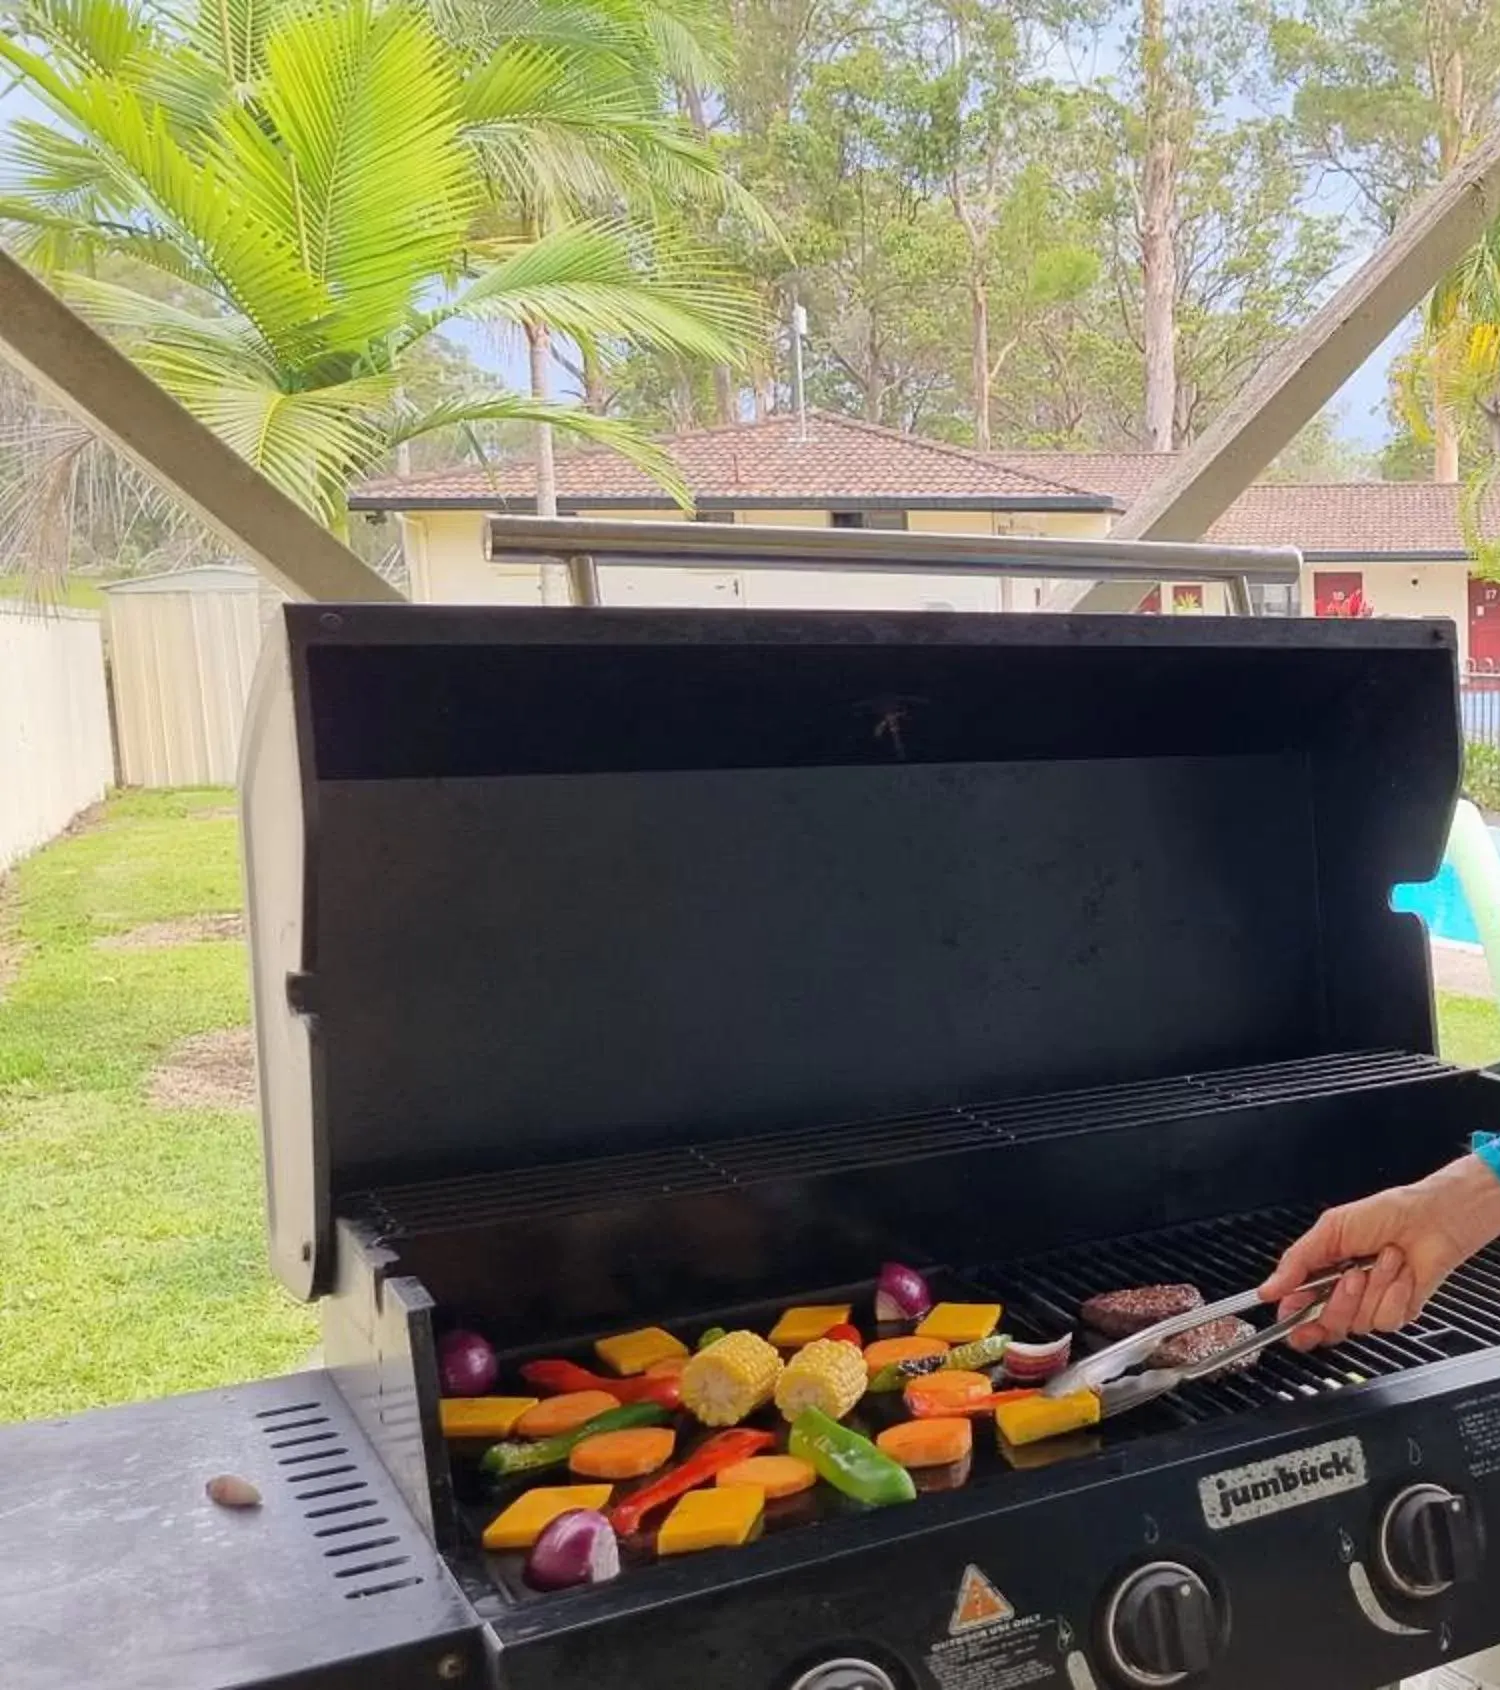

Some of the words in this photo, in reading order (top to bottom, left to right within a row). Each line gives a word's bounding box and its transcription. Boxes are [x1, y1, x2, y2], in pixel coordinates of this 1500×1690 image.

[1485, 589, 1498, 600] 17
[1216, 1449, 1357, 1517] jumbuck
[989, 1622, 1010, 1636] USE
[1013, 1613, 1041, 1629] ONLY
